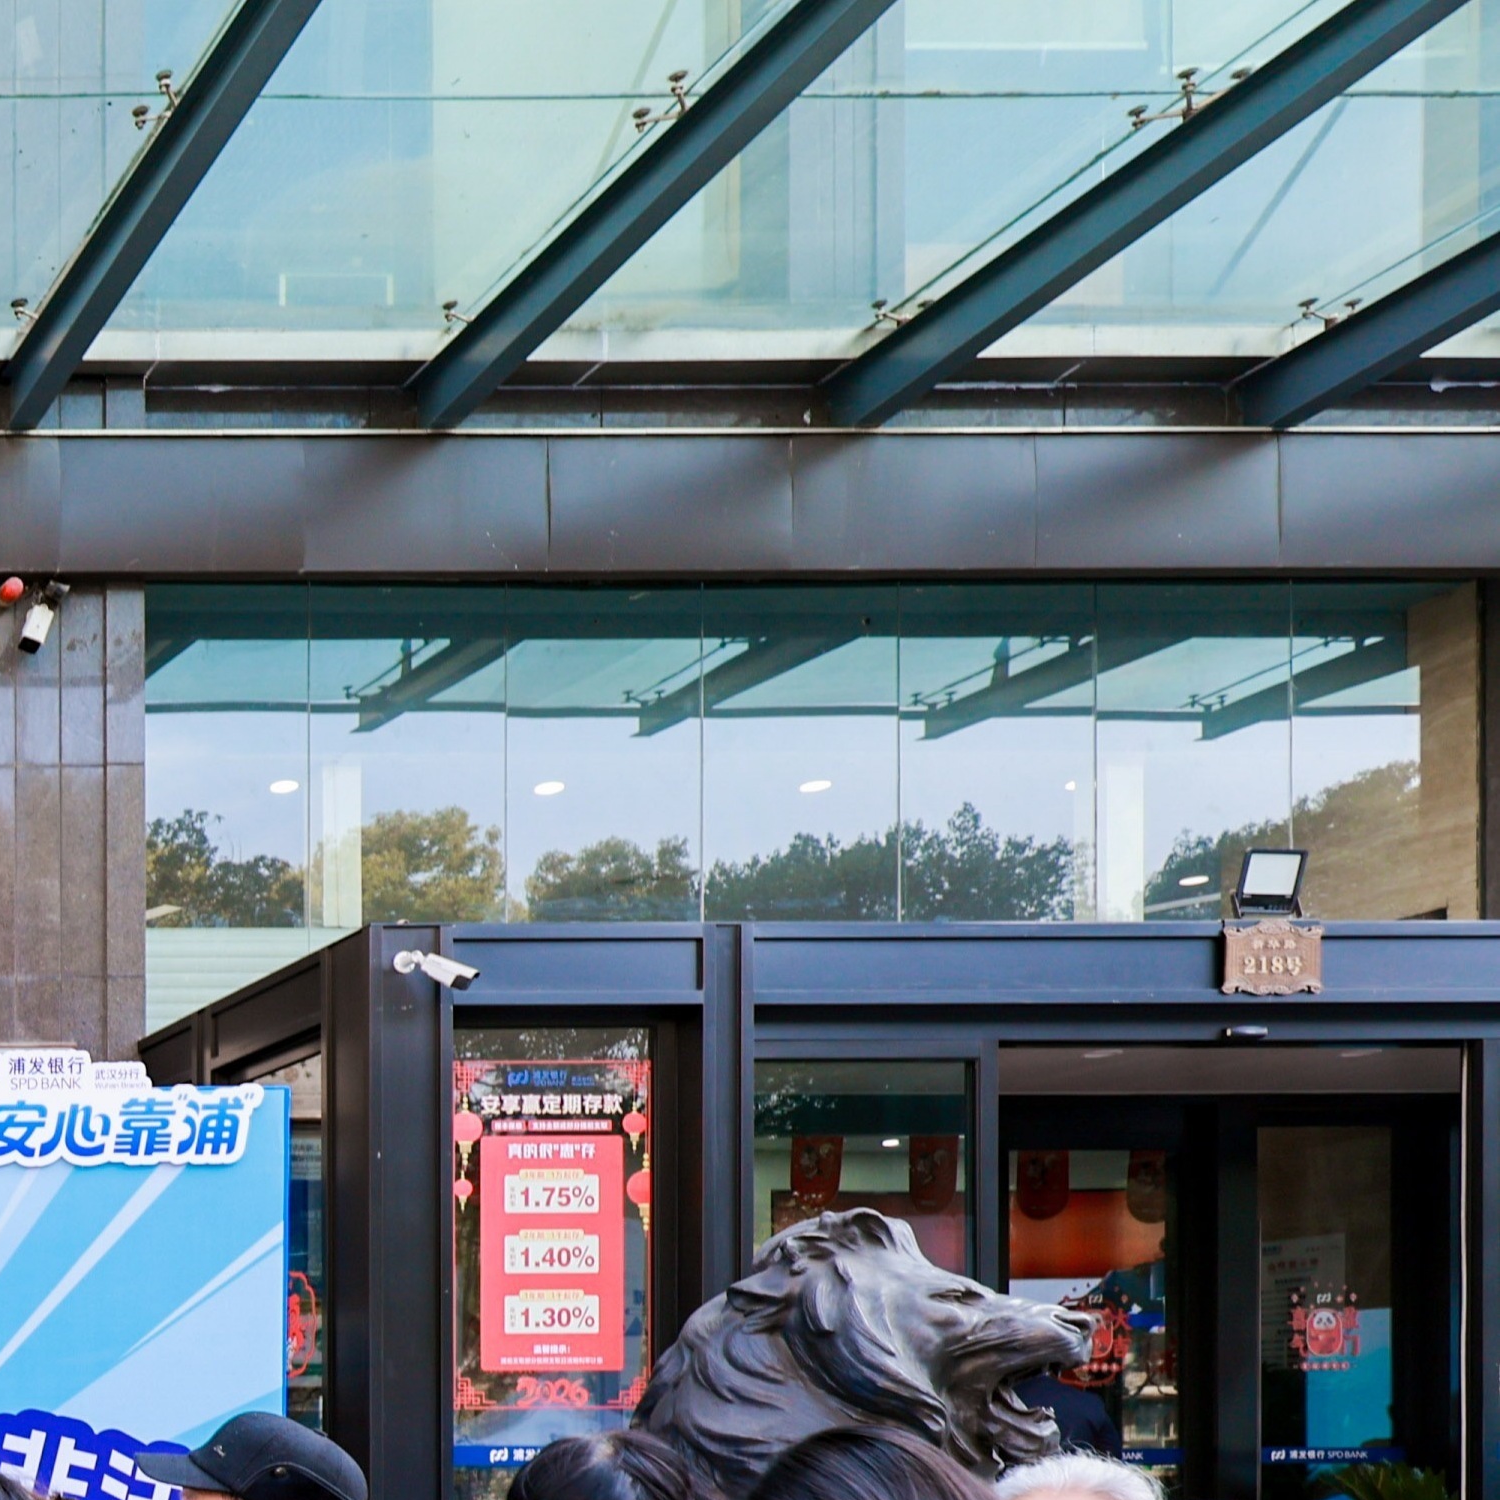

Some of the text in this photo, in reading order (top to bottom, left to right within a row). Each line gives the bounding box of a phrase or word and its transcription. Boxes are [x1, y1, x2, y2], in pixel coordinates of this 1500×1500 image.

[1244, 955, 1303, 976] 218号
[9, 1057, 85, 1075] 浦发银行
[94, 1068, 140, 1080] 武汉分行
[10, 1076, 82, 1091] SPD BANK
[480, 1094, 623, 1115] 安享赢定期存款
[520, 1186, 595, 1208] 1.75%
[520, 1246, 595, 1268] 1.40%
[520, 1306, 595, 1328] 1.30%
[515, 1376, 590, 1407] 2026
[1345, 1451, 1368, 1459] BANK
